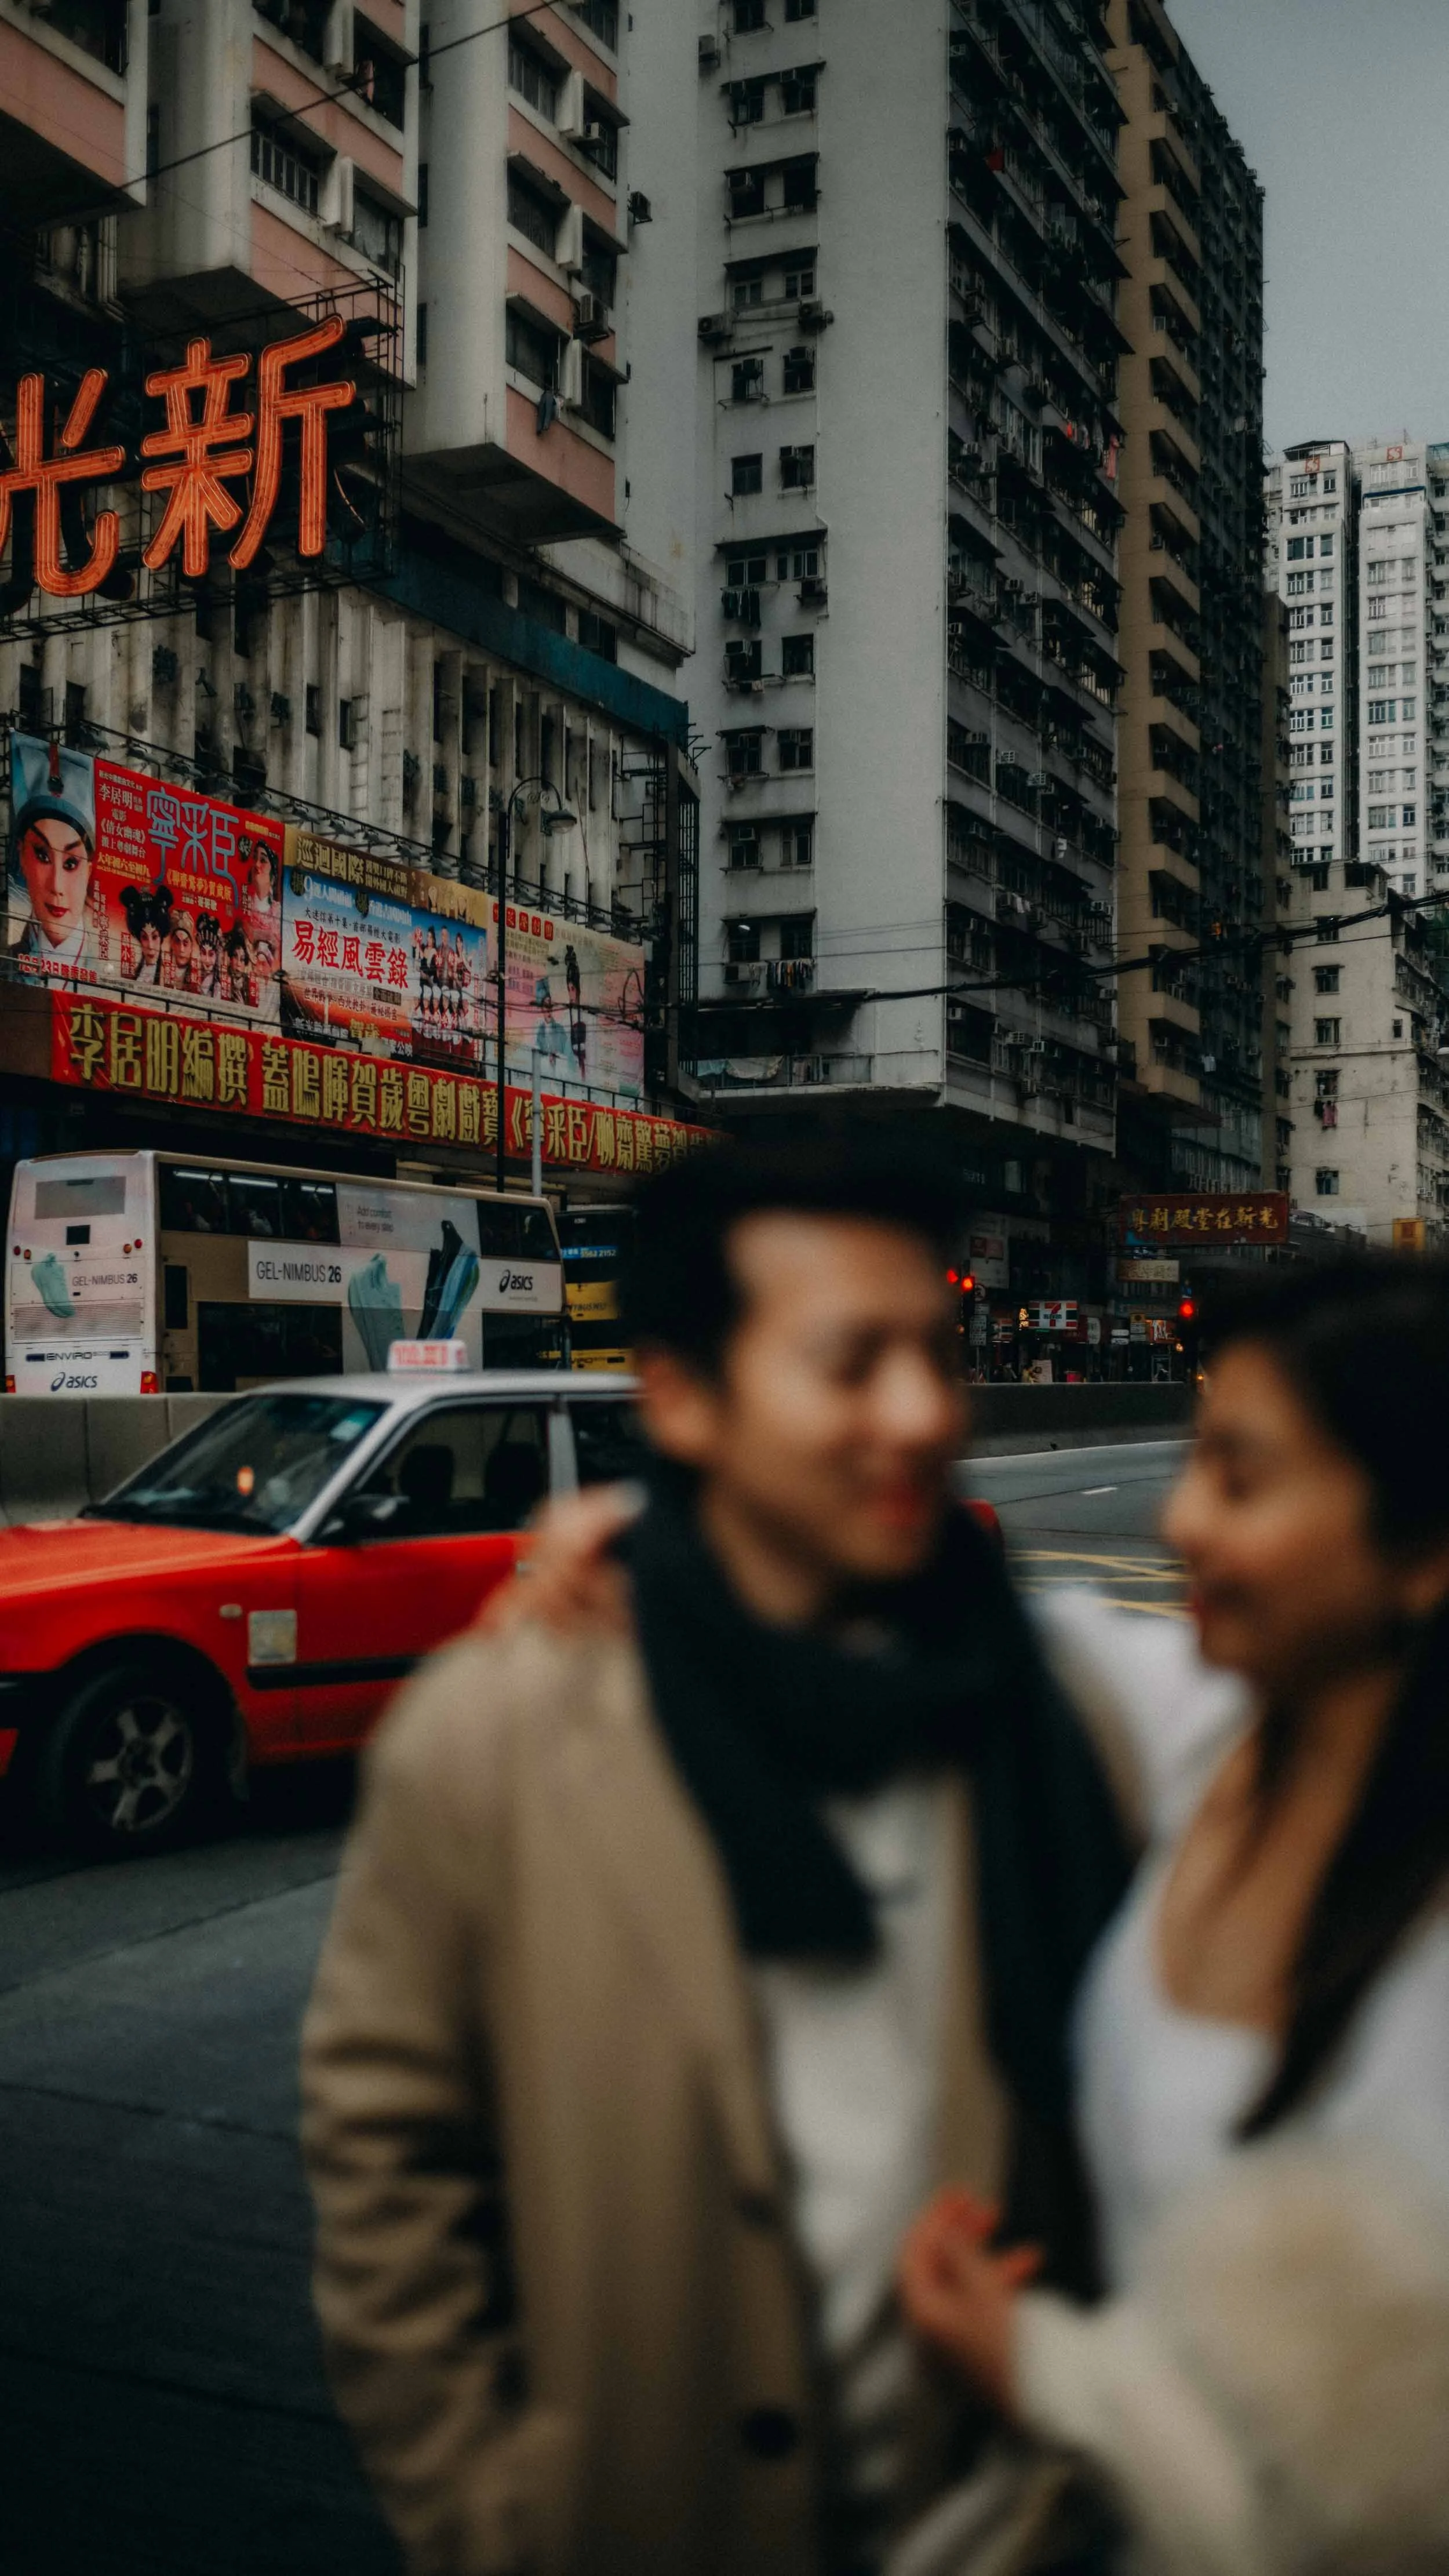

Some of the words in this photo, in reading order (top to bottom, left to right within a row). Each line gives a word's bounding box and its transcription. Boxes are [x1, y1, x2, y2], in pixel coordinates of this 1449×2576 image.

[99, 783, 133, 809] 李居明
[297, 835, 367, 885] 巡迴國際
[292, 919, 409, 989] 易經風雲錄
[70, 1003, 247, 1106] 李居明編撰
[72, 1274, 125, 1286] GEL-NIMBUS
[126, 1273, 138, 1283] 26
[257, 1261, 326, 1283] GEL-NIMBUS
[328, 1265, 341, 1283] 26
[511, 1275, 533, 1291] asics
[46, 1351, 93, 1360] ENVIRO
[66, 1375, 98, 1389] asics
